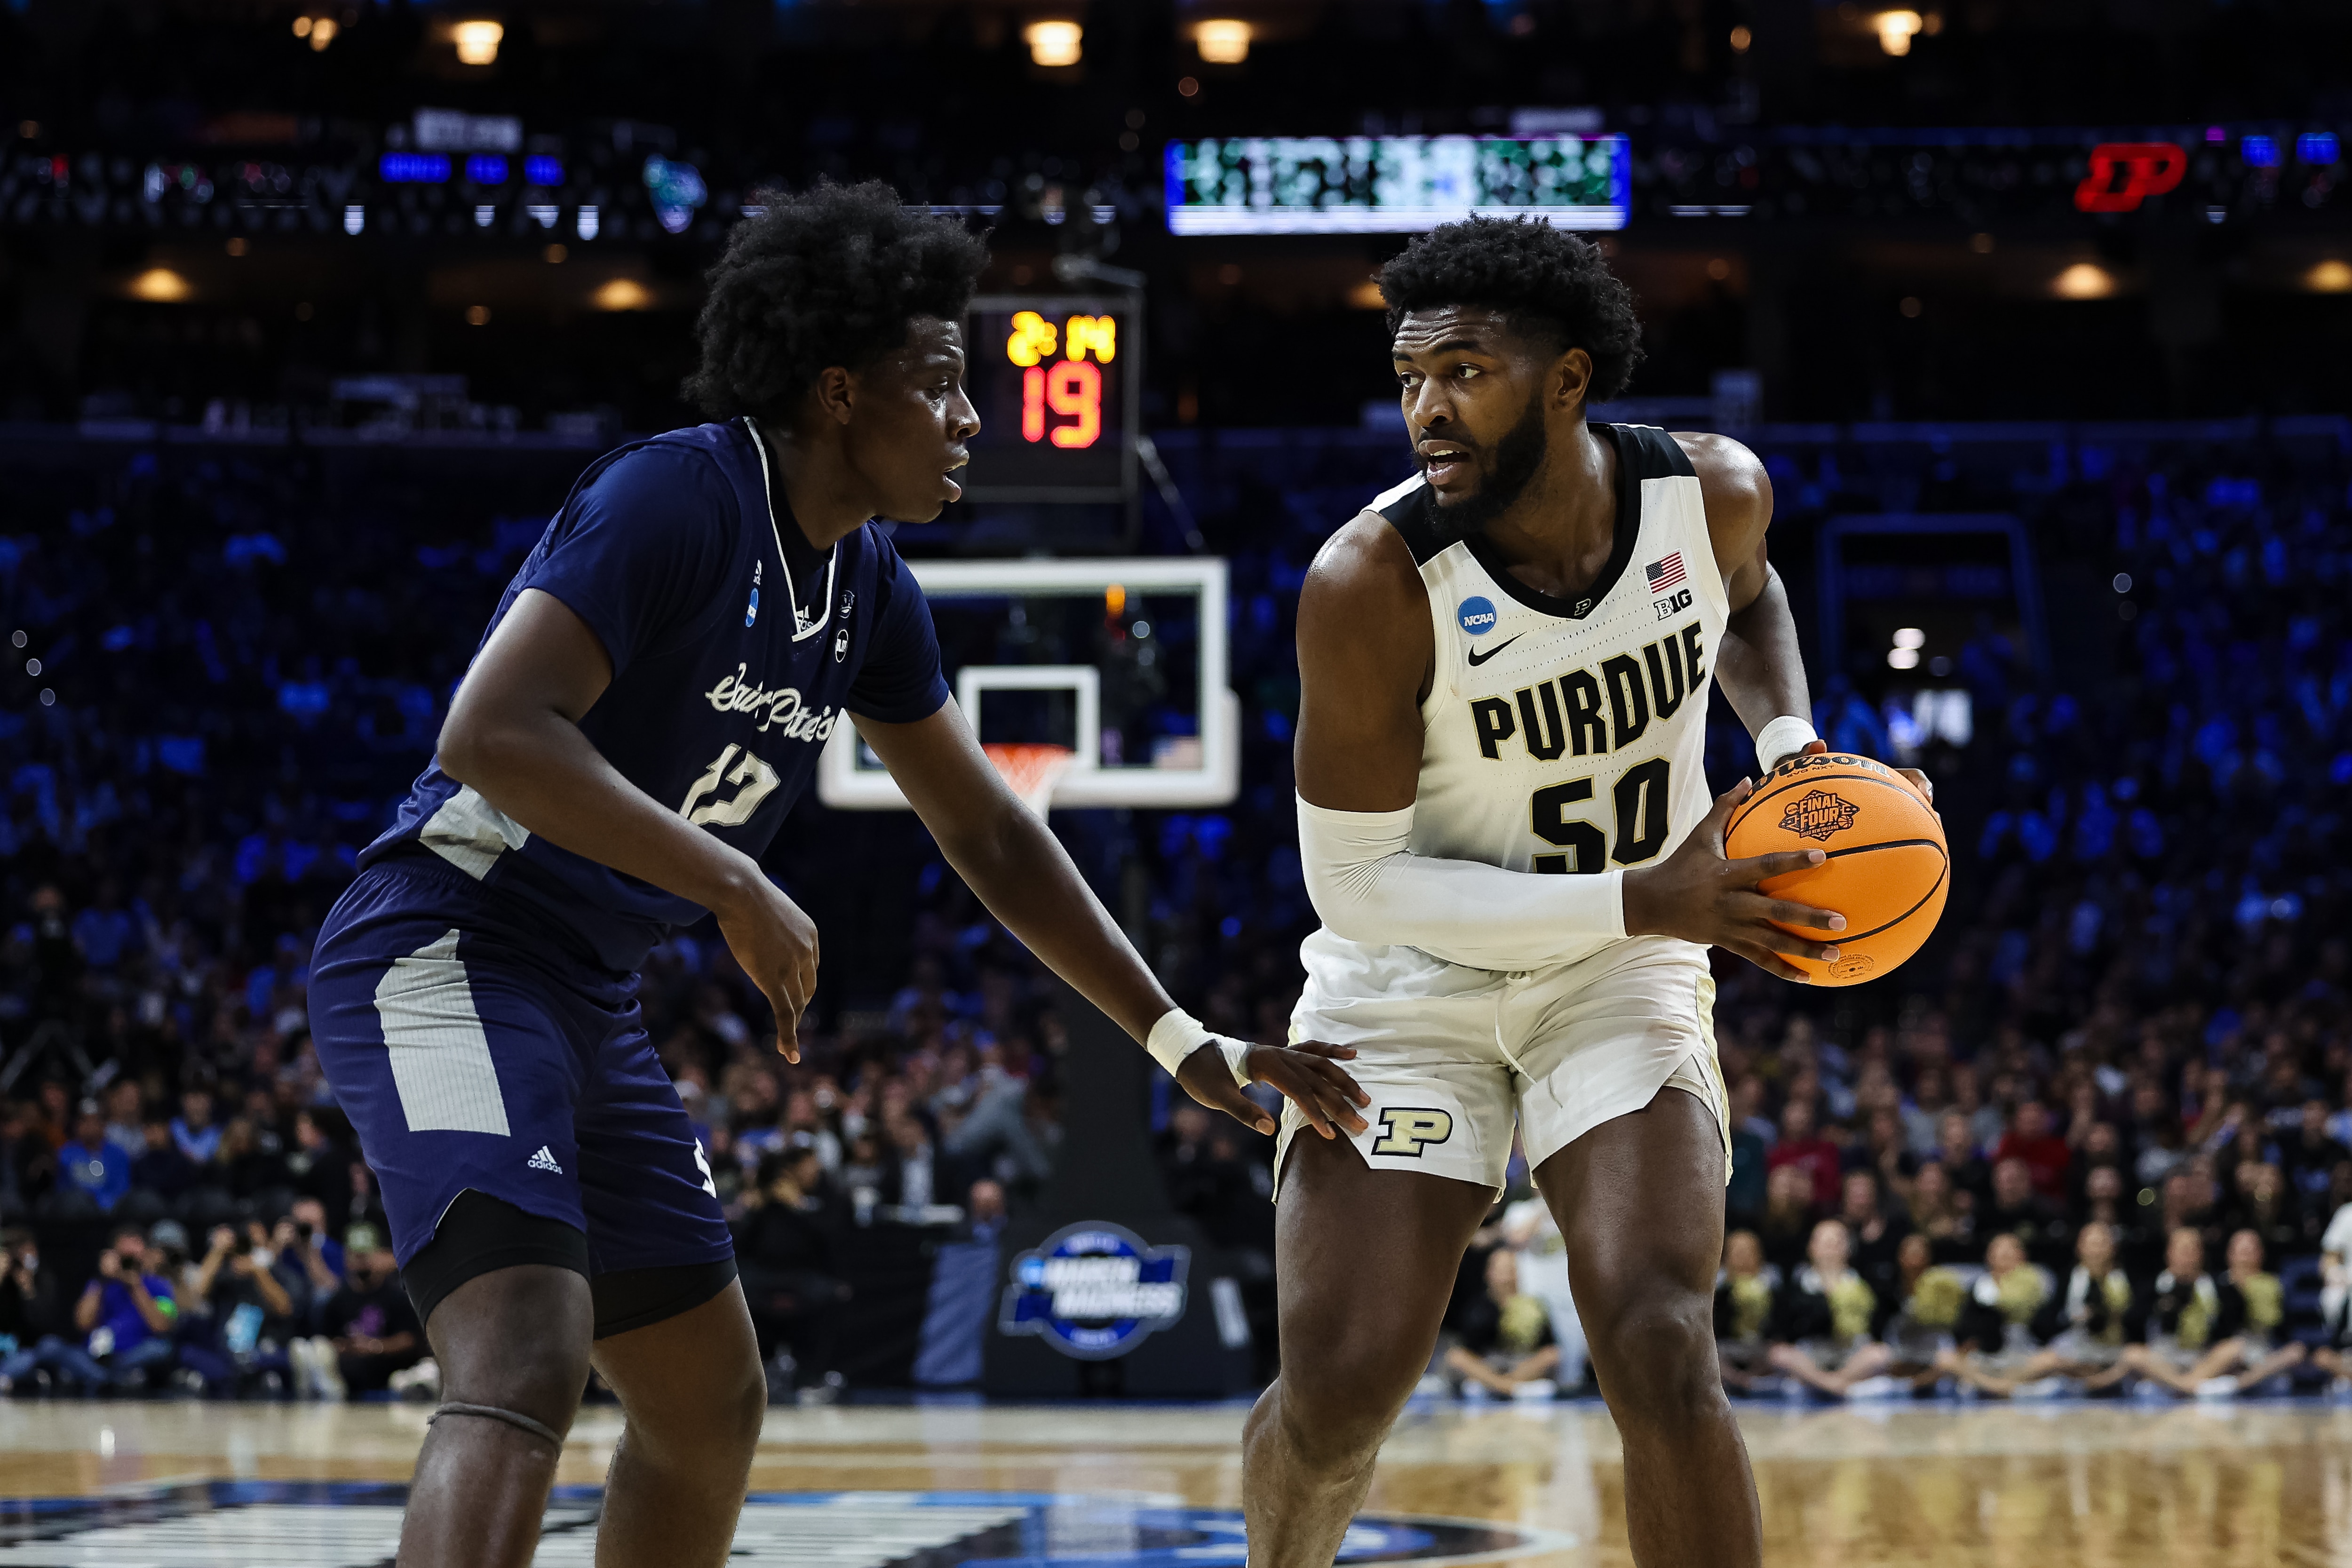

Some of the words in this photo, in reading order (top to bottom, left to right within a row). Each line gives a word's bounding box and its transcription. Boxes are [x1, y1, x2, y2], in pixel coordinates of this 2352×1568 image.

[1023, 360, 1101, 448] 19
[1574, 598, 1591, 616] P
[1464, 613, 1494, 626] NCAA
[1468, 619, 1706, 762] PURDUE
[1529, 756, 1672, 874] 50
[1799, 794, 1839, 814] FINAL
[1800, 807, 1839, 829] FOUR
[1371, 1107, 1453, 1159] P
[527, 1160, 563, 1175] adidas
